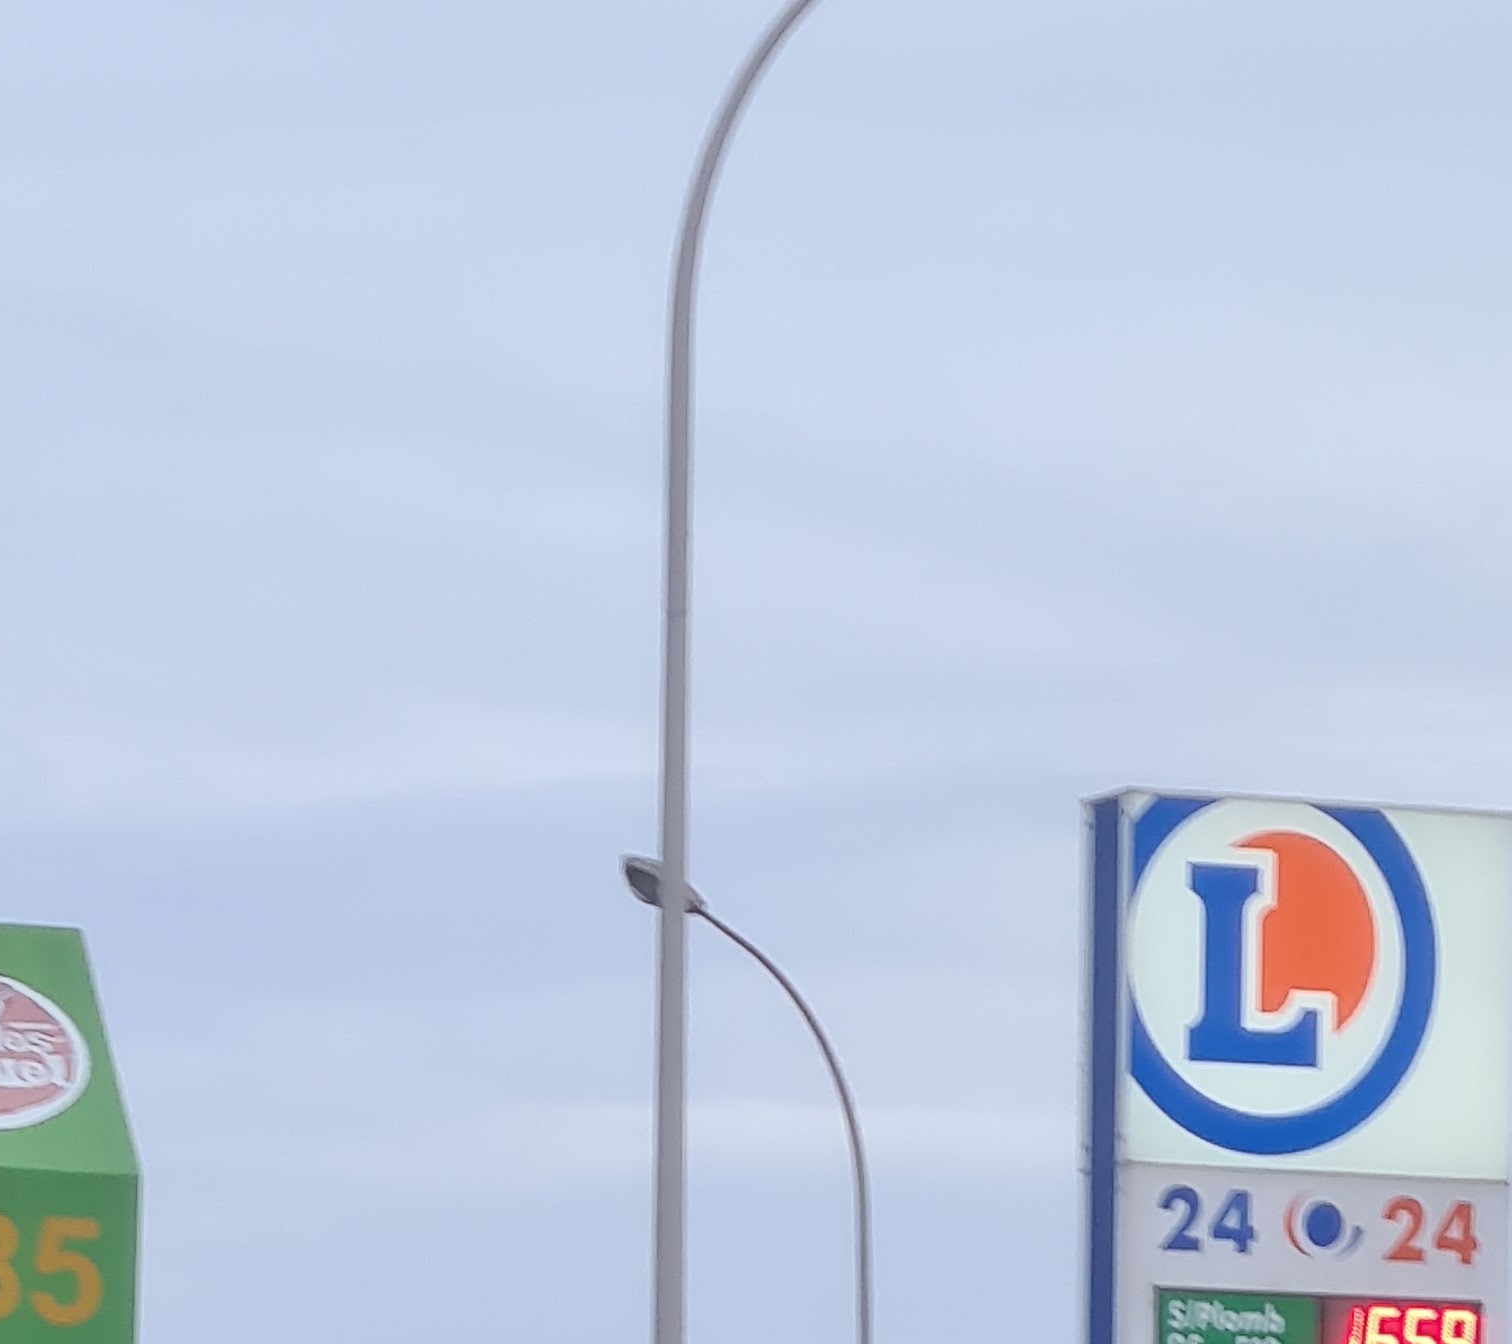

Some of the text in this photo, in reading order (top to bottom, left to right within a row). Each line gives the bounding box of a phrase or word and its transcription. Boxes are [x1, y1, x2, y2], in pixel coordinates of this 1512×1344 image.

[1189, 861, 1318, 1067] L
[1159, 1184, 1478, 1265] 24 24
